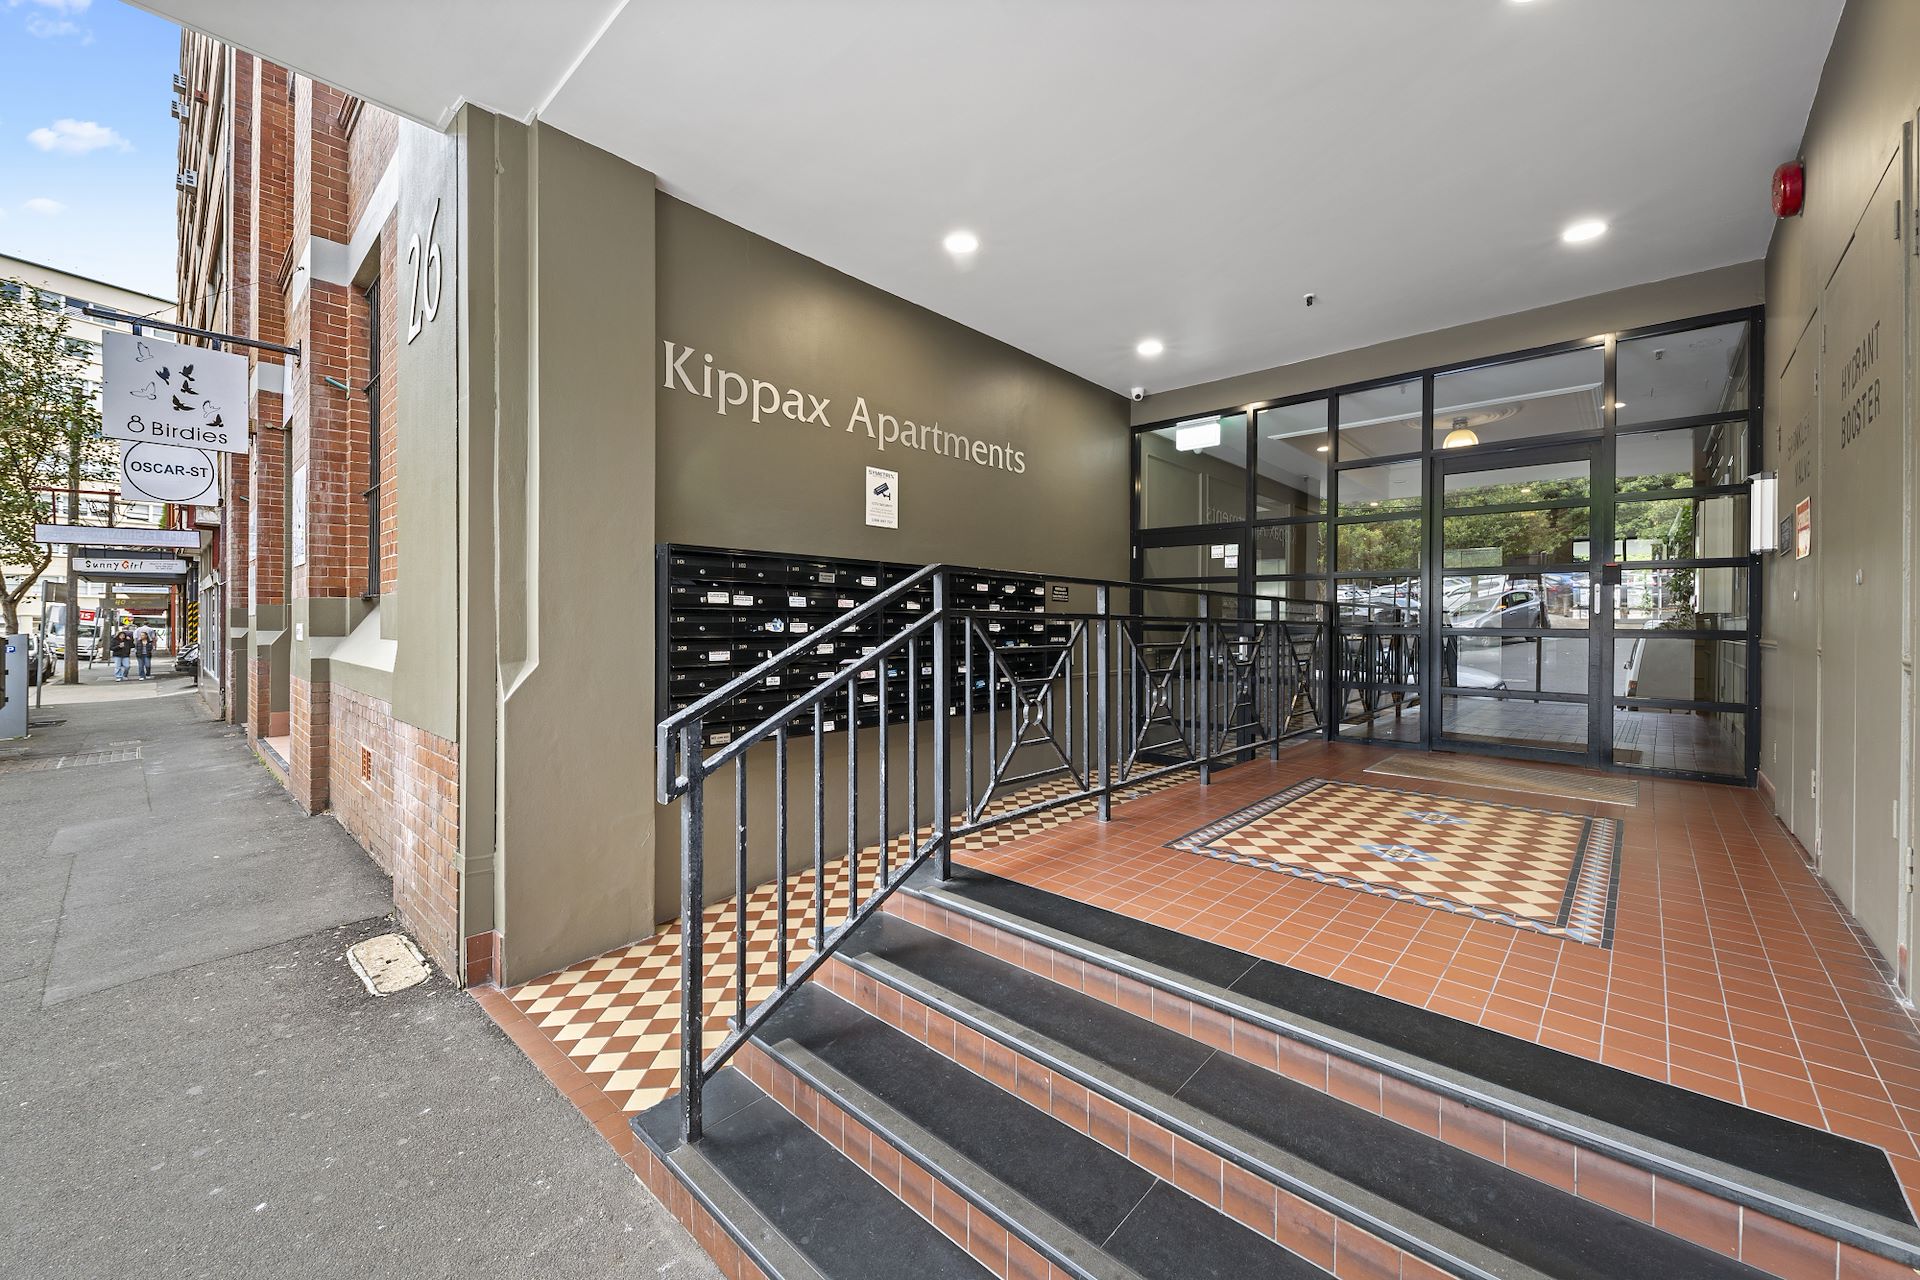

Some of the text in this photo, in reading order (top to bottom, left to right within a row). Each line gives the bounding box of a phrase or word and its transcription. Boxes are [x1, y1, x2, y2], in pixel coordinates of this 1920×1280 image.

[407, 197, 442, 345] 26
[1841, 319, 1880, 401] HYDRANT
[127, 415, 228, 445] 8 Birdies
[661, 340, 1026, 475] Kippax Apartments
[1841, 377, 1881, 450] BOOSTER
[130, 461, 208, 478] OSCAR-ST
[85, 560, 119, 570] Sunny
[121, 560, 143, 570] Girl
